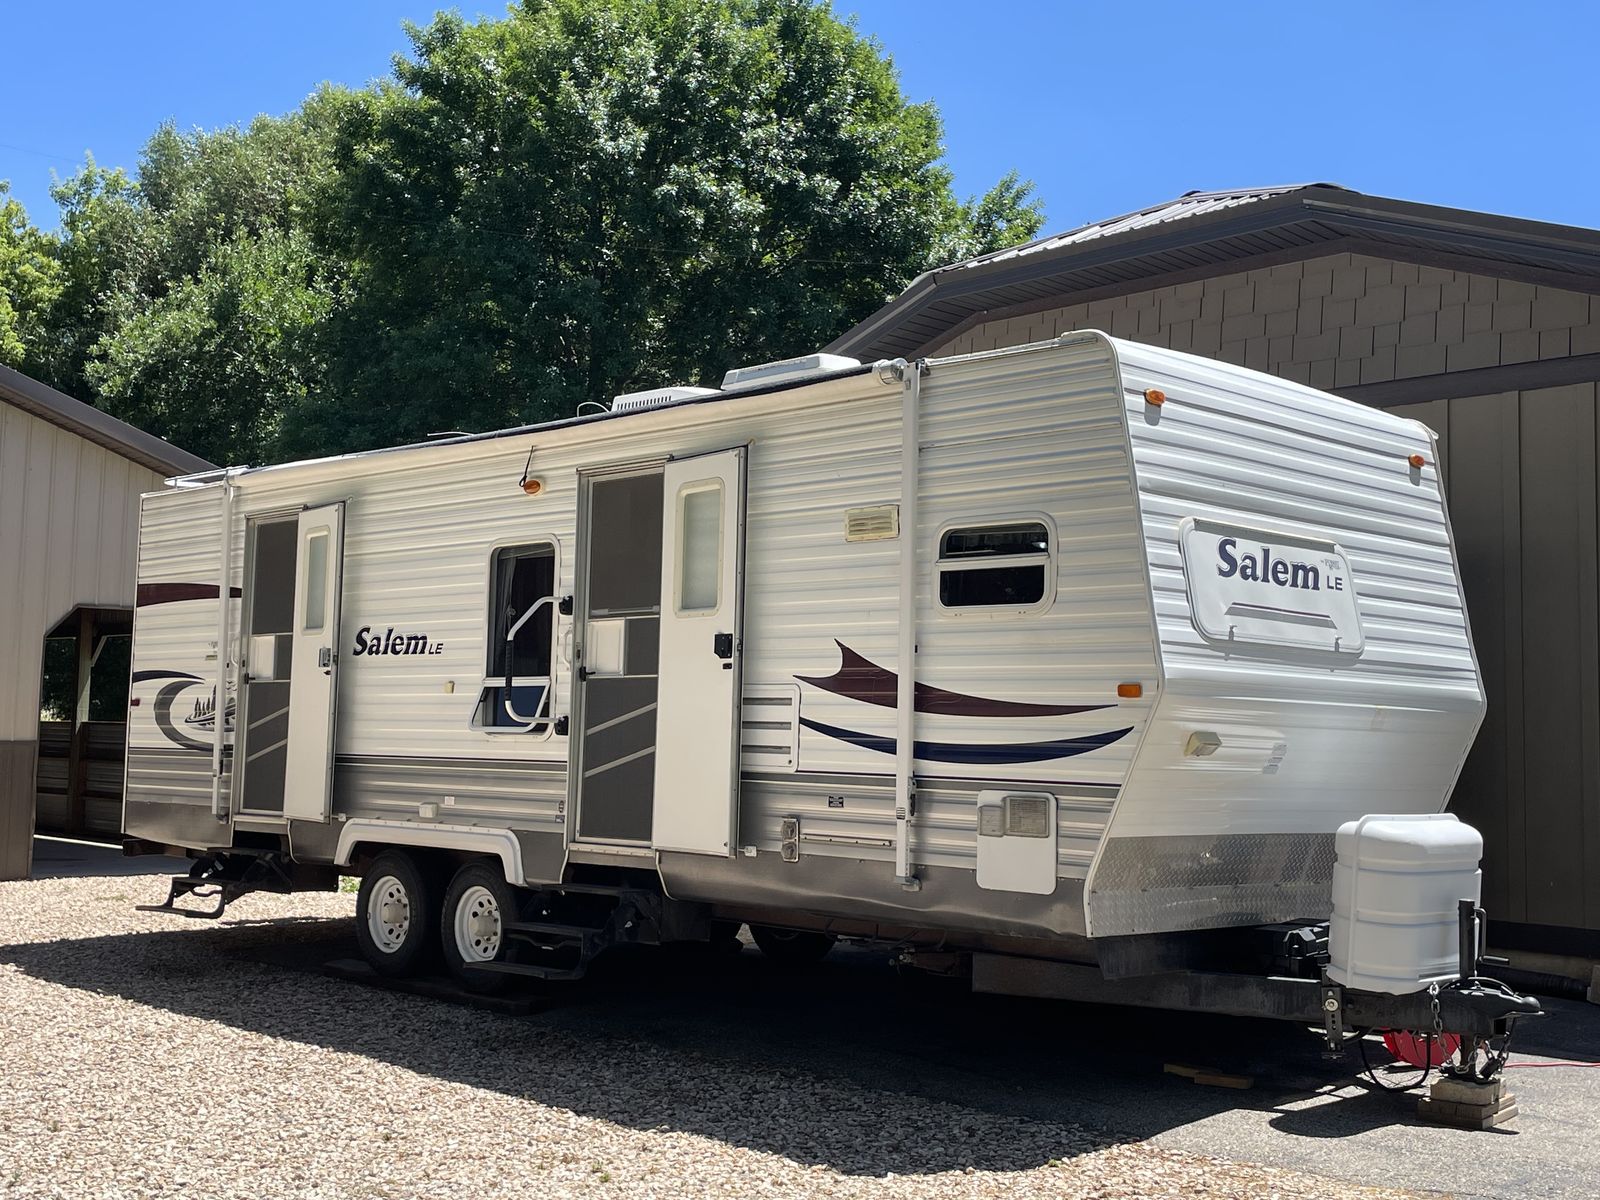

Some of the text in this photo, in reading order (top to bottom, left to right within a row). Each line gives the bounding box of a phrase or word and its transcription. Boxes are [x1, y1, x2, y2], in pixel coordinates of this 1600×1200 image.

[1217, 537, 1343, 591] Salem LE
[352, 625, 444, 656] Salem LE
